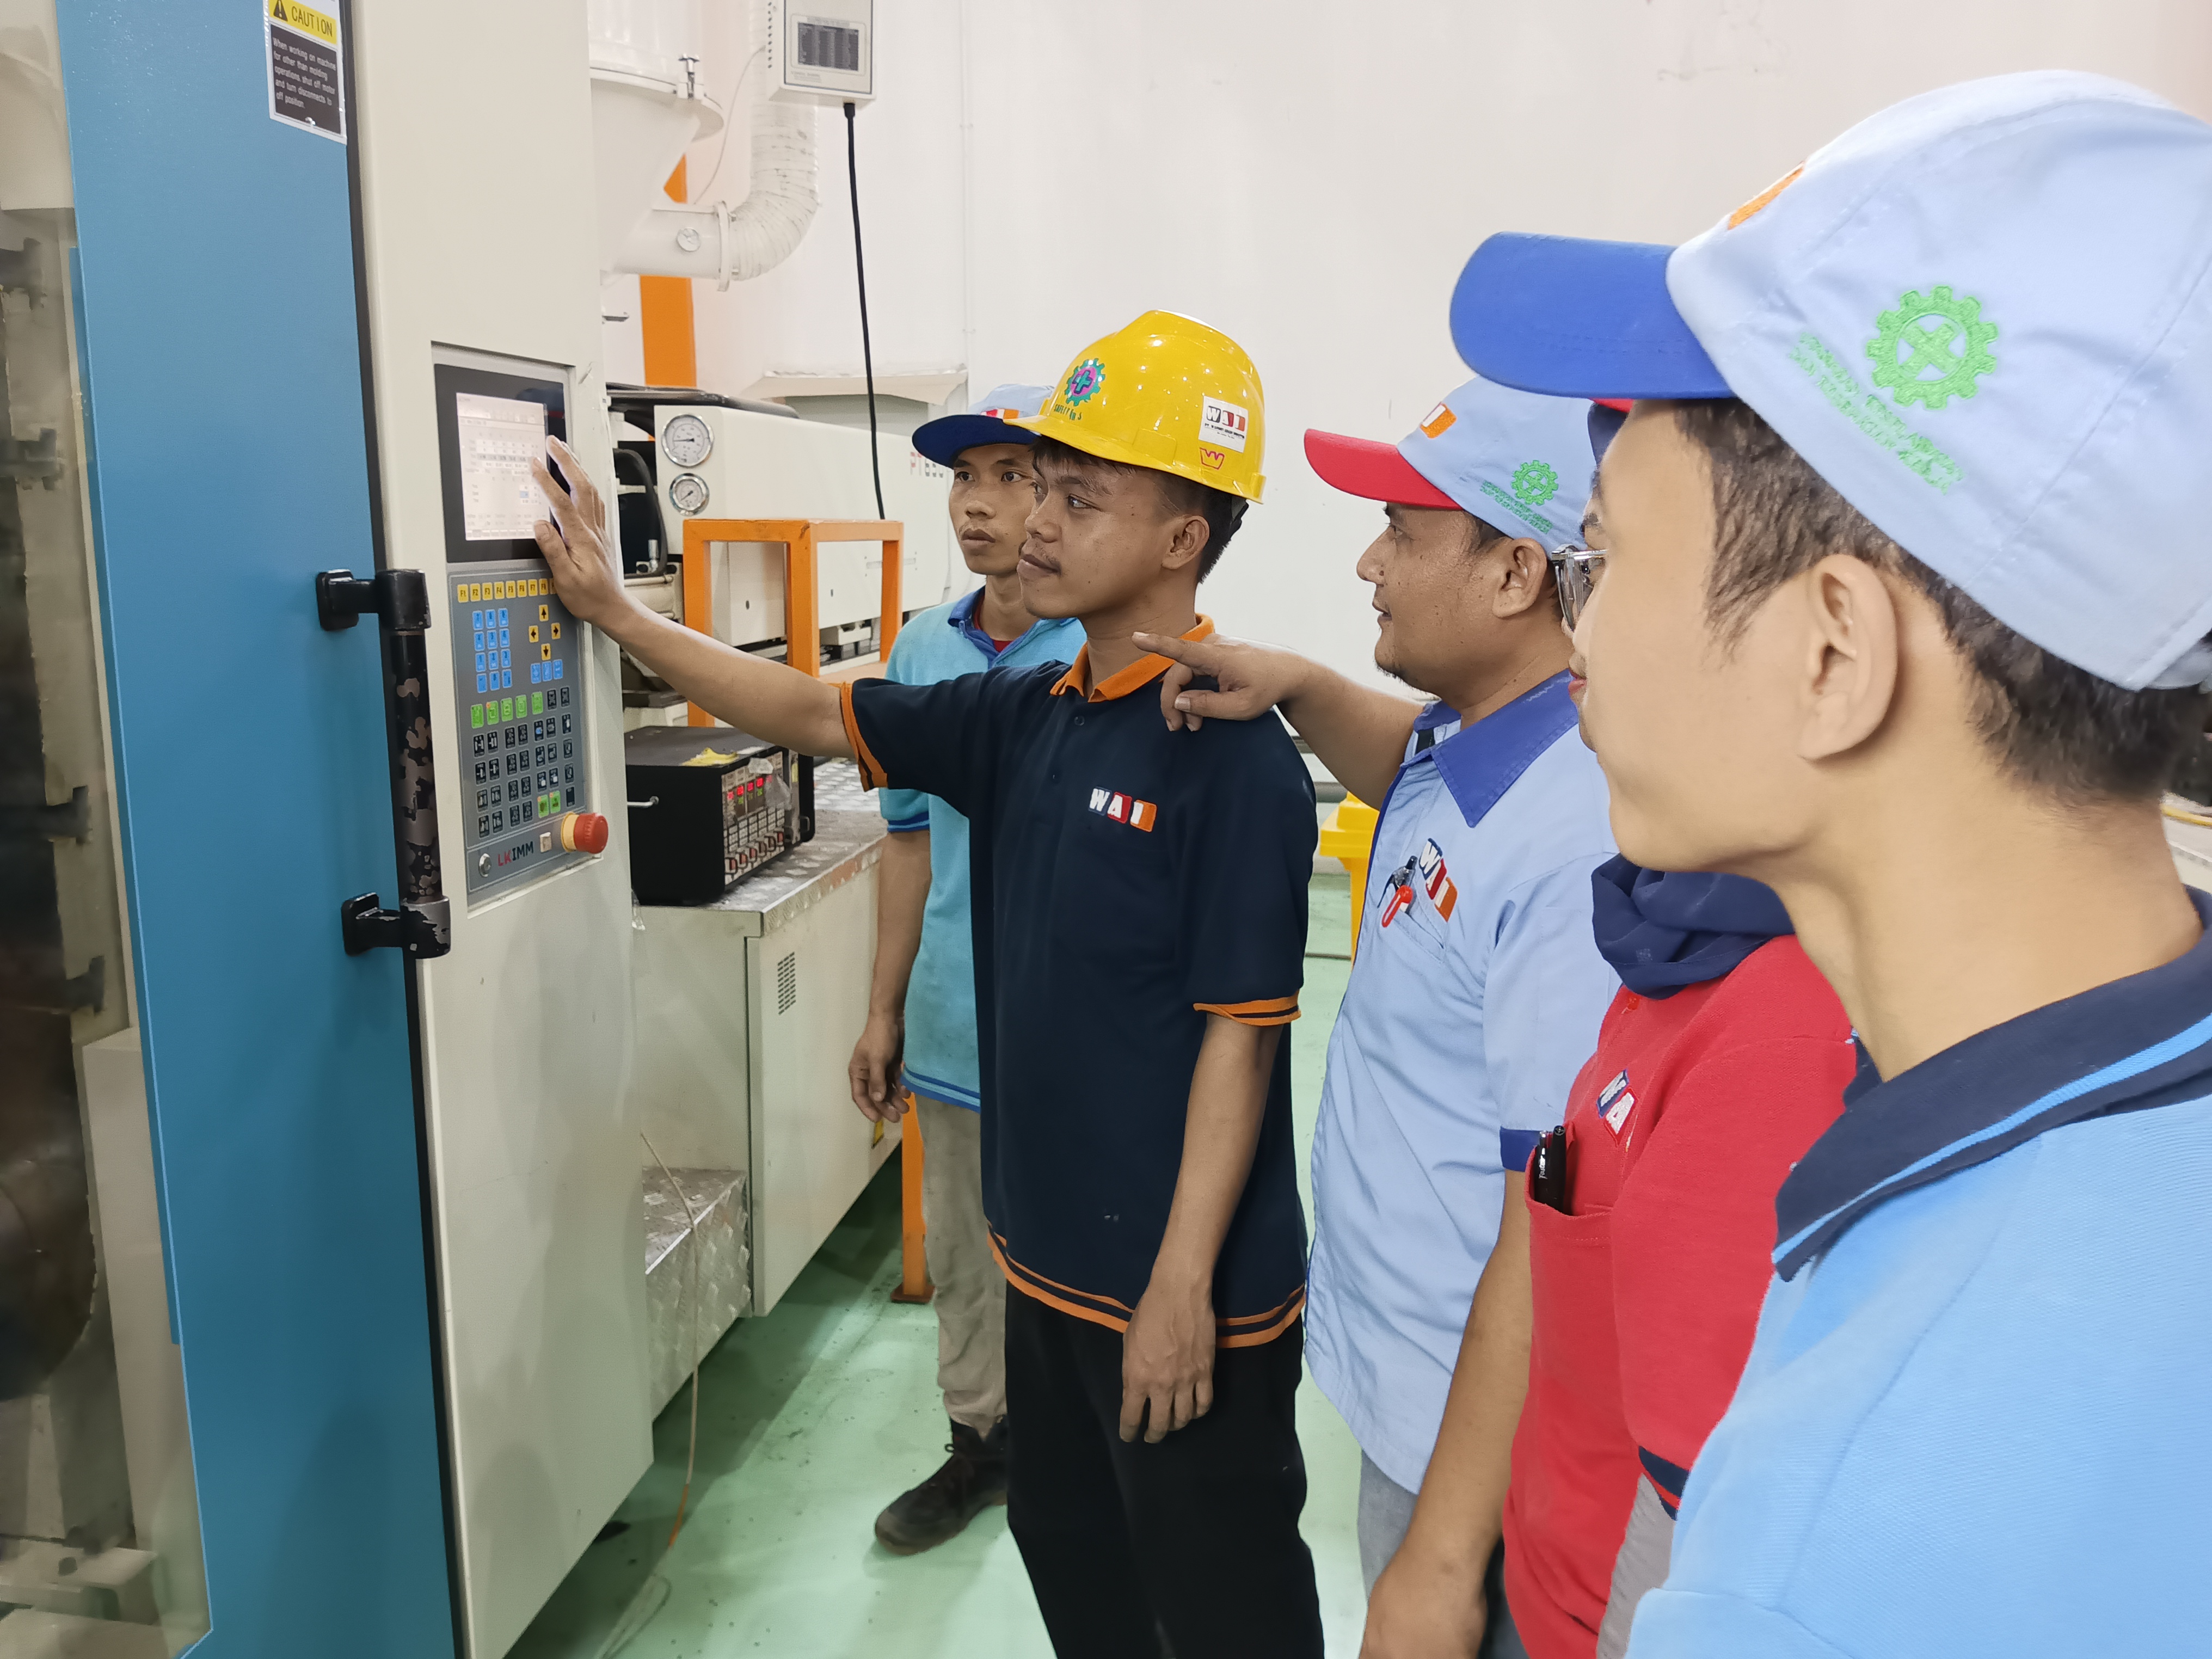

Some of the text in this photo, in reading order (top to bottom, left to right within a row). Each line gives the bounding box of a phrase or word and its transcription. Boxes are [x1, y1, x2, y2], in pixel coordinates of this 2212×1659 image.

[291, 6, 333, 37] CAUTION
[273, 37, 288, 51] When
[288, 46, 308, 61] working
[460, 589, 466, 598] F1
[1088, 787, 1157, 832] WAI
[497, 841, 534, 867] LKIMM
